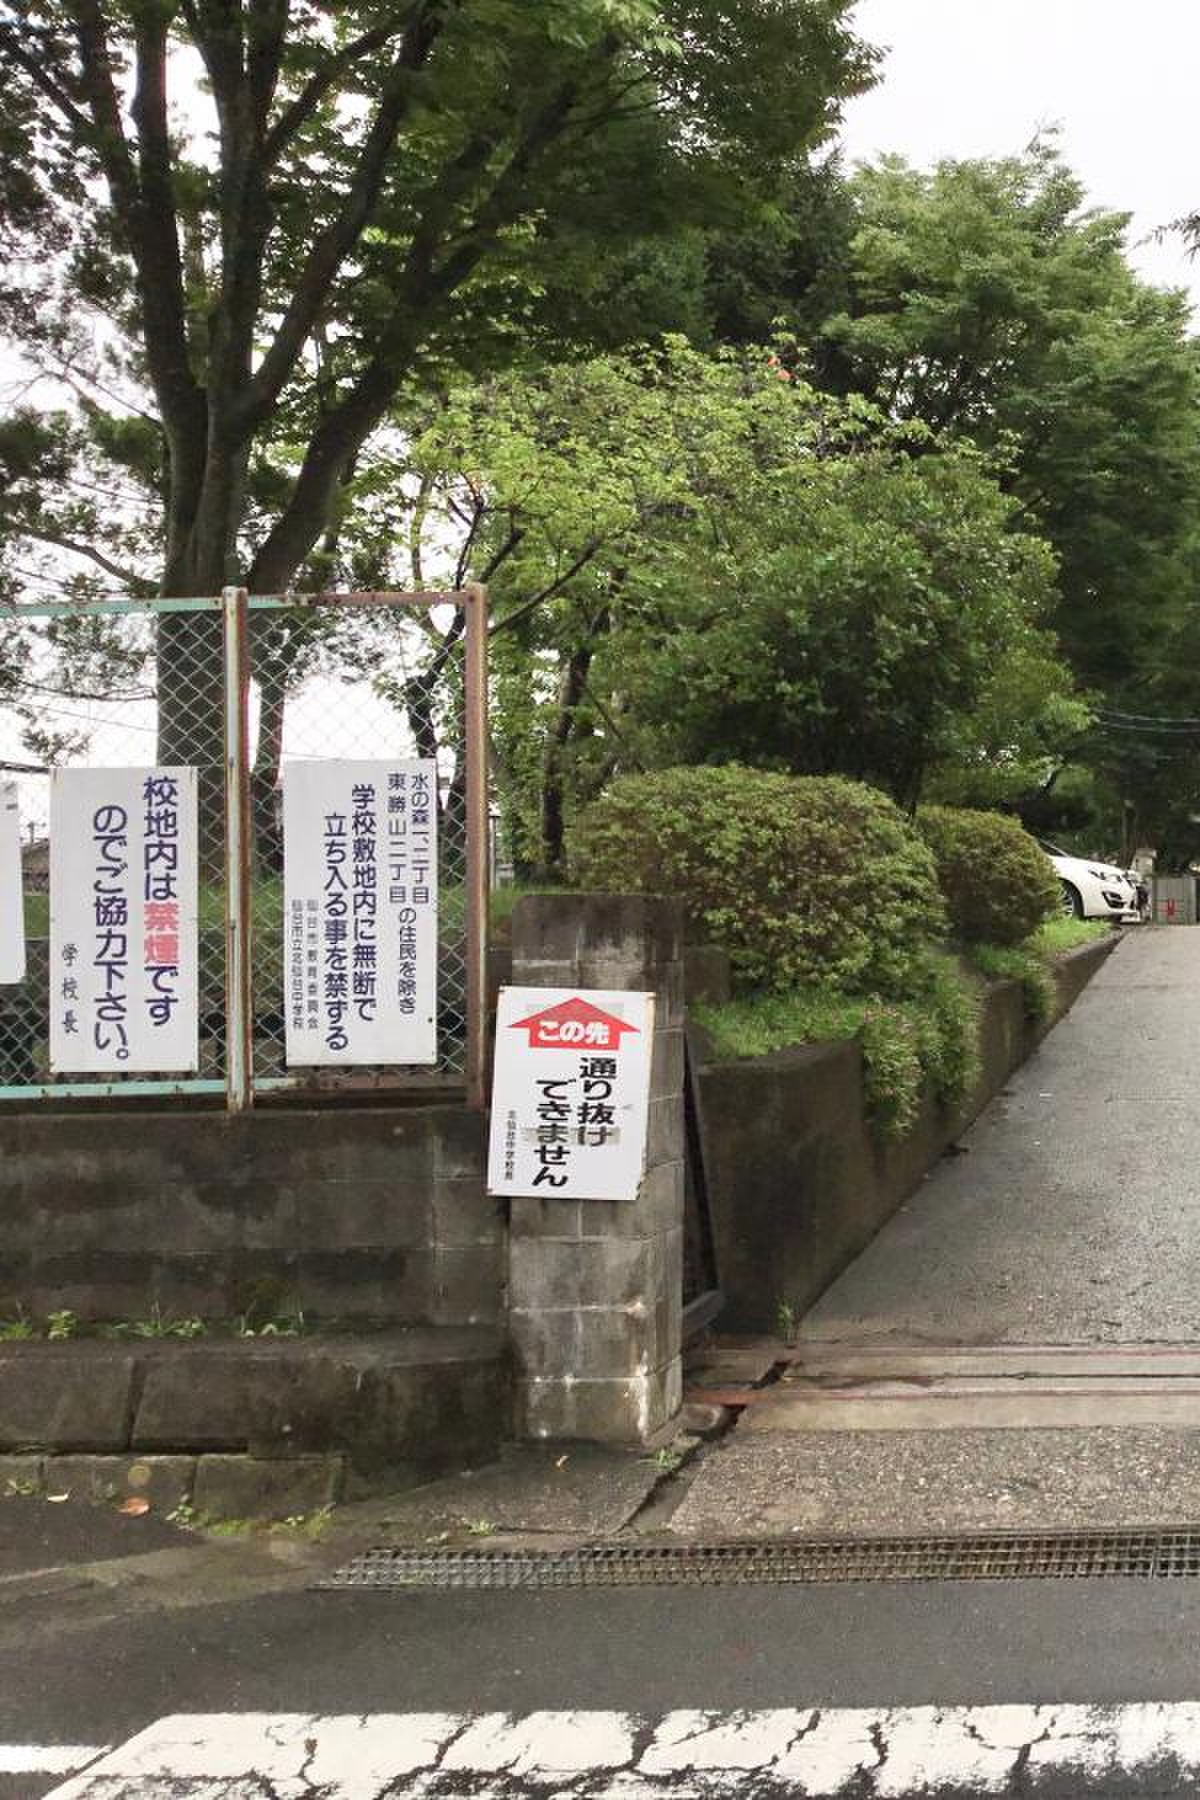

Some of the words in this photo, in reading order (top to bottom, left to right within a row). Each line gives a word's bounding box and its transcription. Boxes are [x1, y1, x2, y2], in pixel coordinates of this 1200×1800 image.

[92, 804, 130, 1061] のでご協力下さい。
[143, 776, 179, 1027] 校地内は禁煙です
[323, 812, 349, 1052] 立ち入る事を禁ずる
[351, 784, 377, 1023] 学校敷地内に無断で
[399, 907, 417, 1015] の住民を除き
[537, 1021, 609, 1044] この先
[577, 1057, 617, 1147] 通り抜け
[531, 1078, 577, 1187] できません
